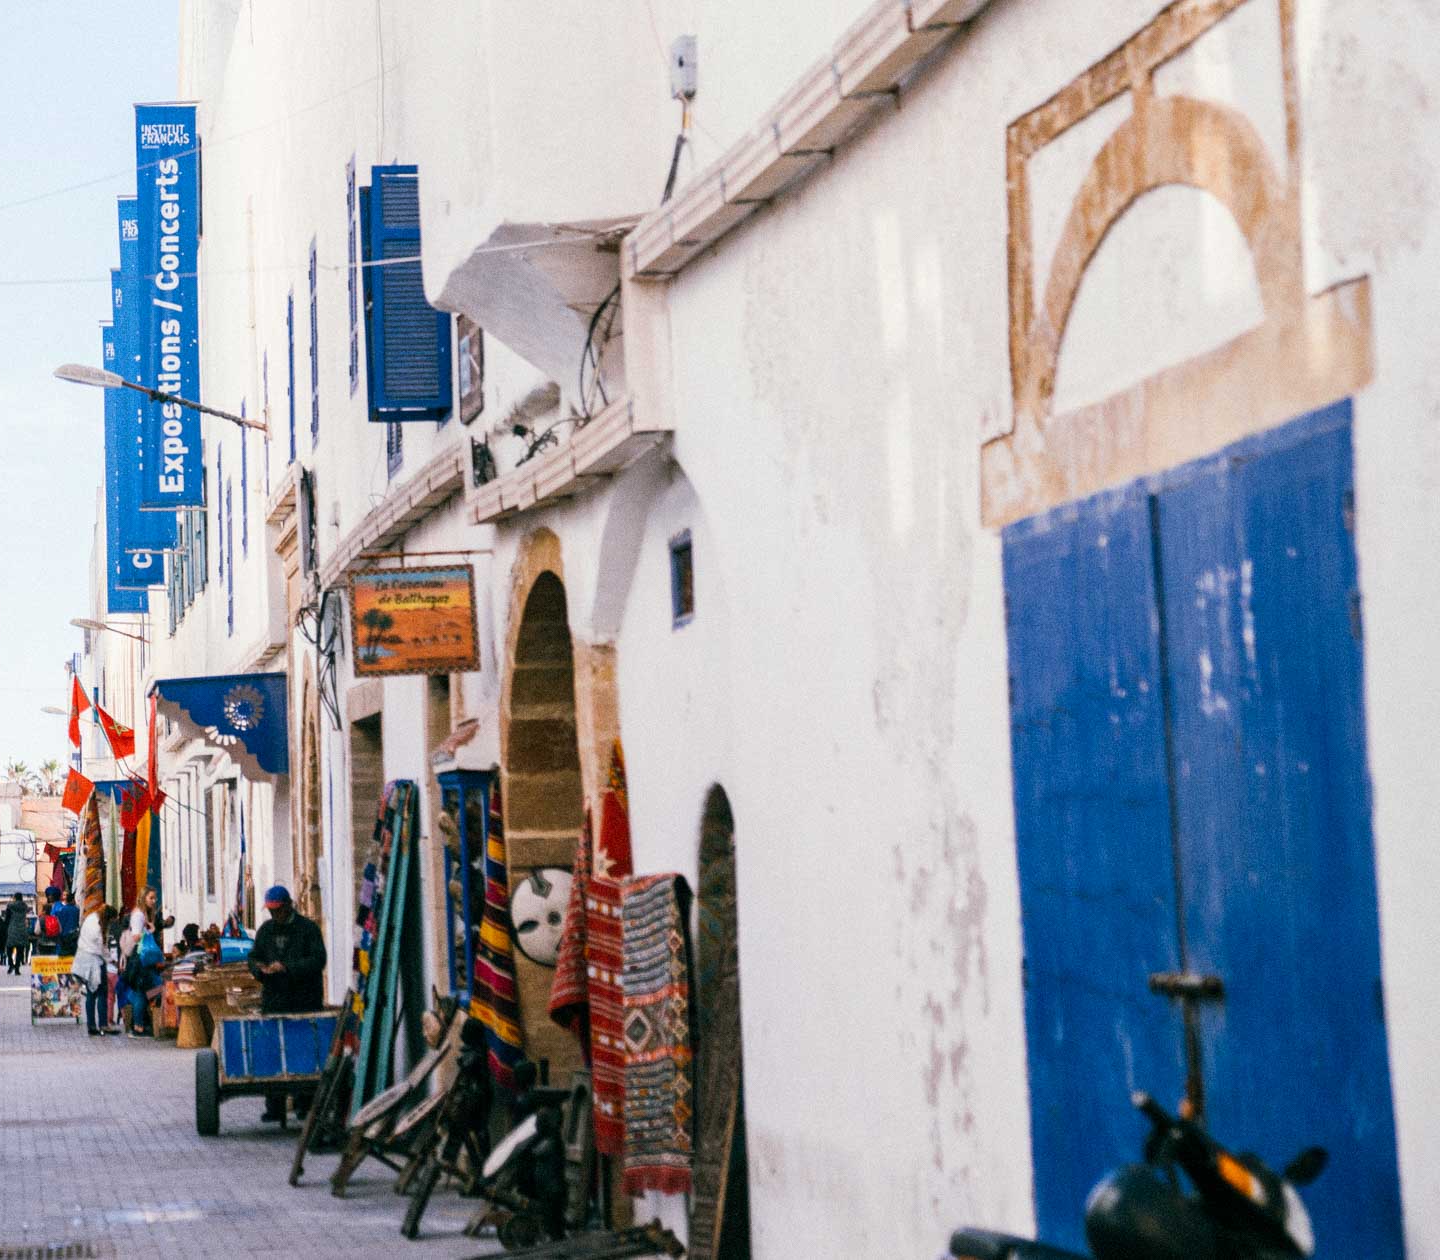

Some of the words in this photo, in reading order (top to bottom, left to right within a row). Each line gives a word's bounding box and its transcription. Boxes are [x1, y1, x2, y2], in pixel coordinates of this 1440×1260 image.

[141, 124, 185, 136] INSTITUT
[141, 133, 190, 146] FRANÇAIS
[155, 158, 180, 291] Concerts
[153, 298, 183, 313] /
[158, 320, 185, 493] Expostions
